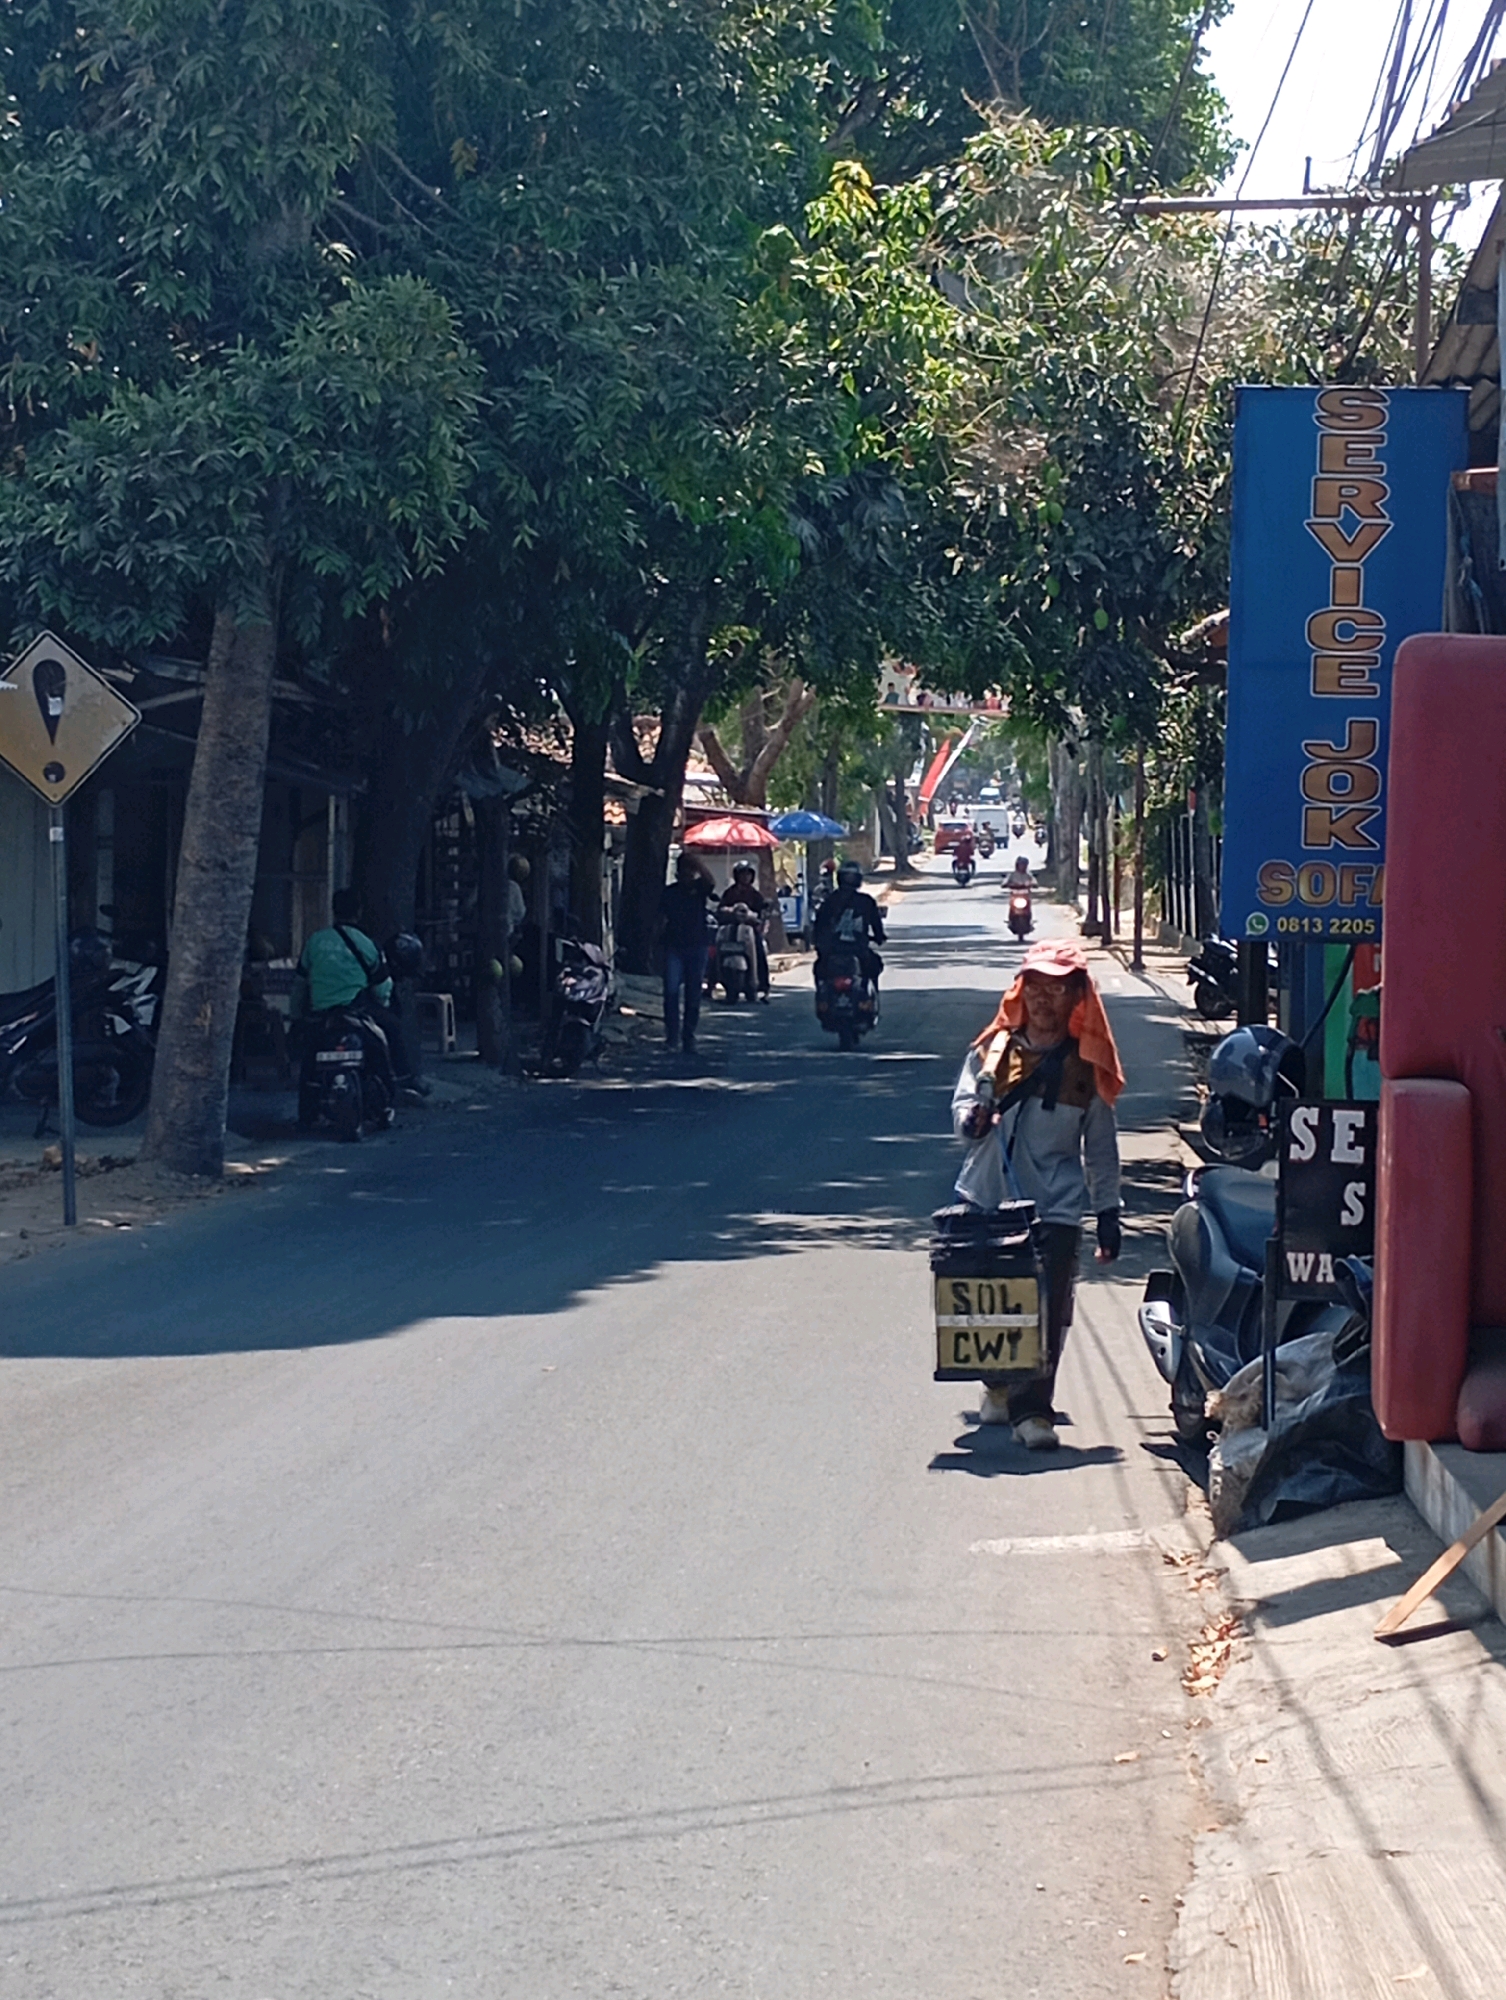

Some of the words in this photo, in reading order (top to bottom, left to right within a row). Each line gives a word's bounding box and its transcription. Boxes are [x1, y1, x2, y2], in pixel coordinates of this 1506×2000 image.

[1304, 388, 1394, 697] SERVICE
[1301, 717, 1381, 850] JOK
[1276, 916, 1323, 934] 0813
[1329, 917, 1375, 934] 2205
[952, 1281, 1022, 1315] SOL
